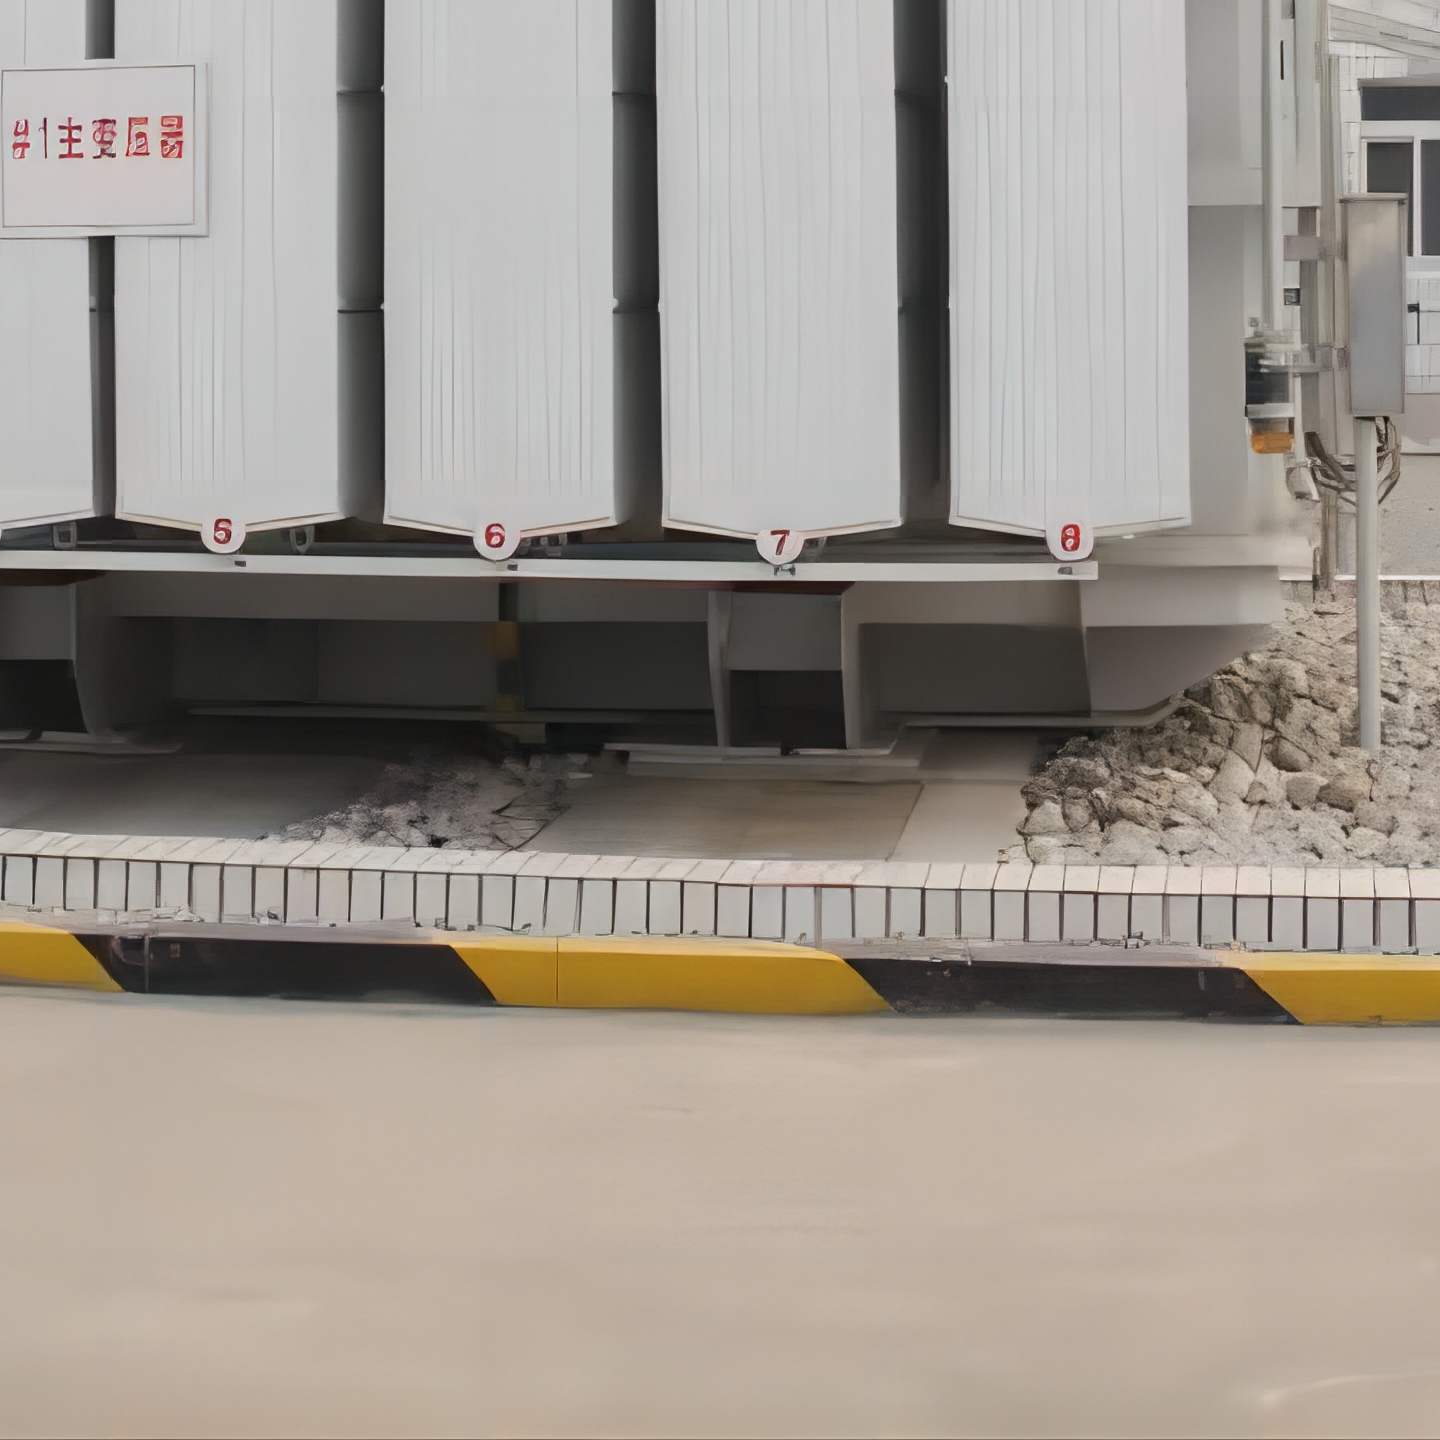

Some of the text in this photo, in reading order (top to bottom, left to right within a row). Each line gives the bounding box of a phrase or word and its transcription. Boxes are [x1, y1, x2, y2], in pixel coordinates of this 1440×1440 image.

[484, 523, 506, 548] 6
[770, 529, 790, 555] 7
[1060, 523, 1081, 552] 8
